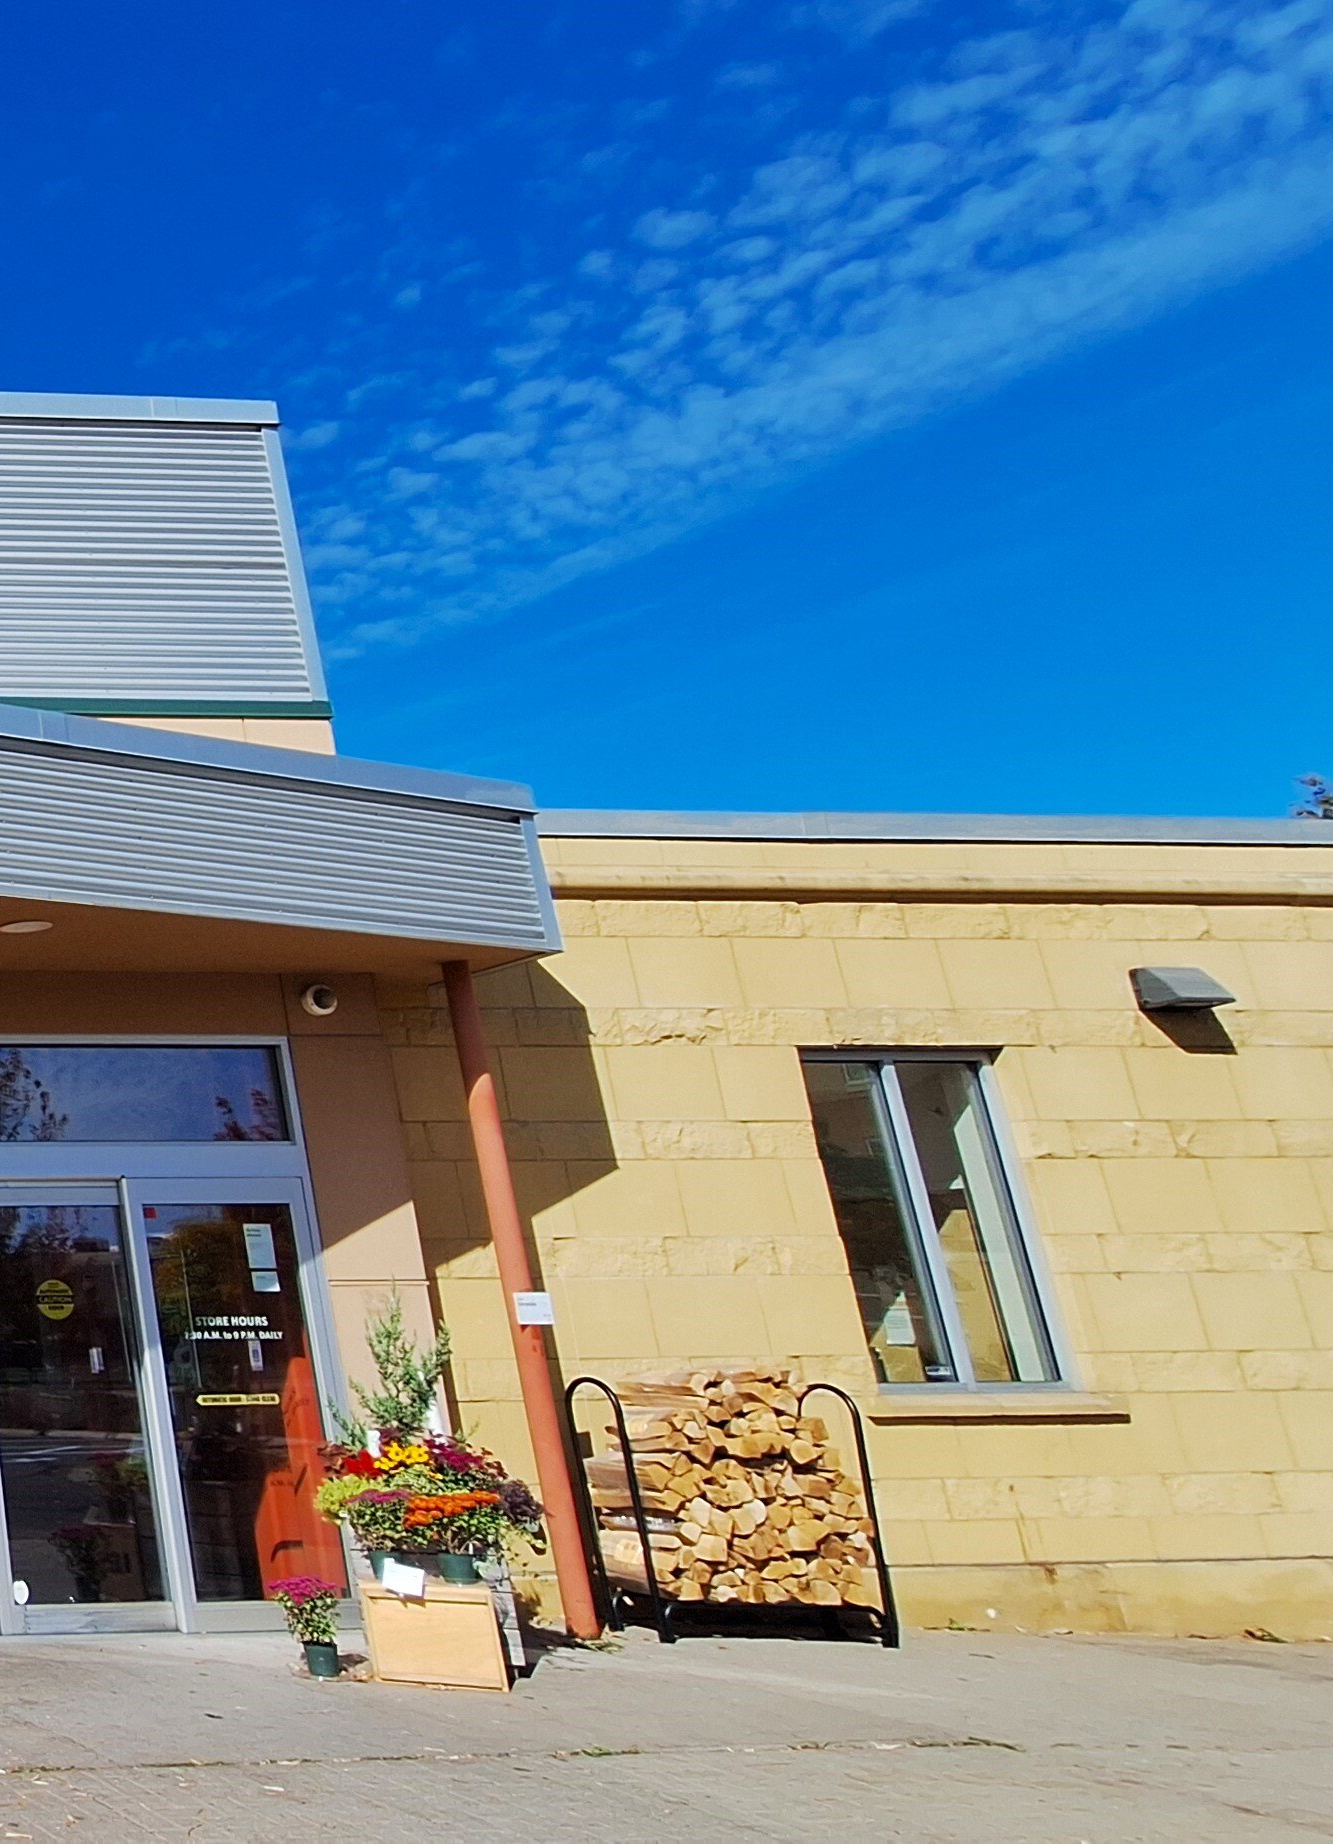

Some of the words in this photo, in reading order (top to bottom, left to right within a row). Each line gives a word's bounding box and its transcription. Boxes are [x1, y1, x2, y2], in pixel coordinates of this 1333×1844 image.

[195, 1316, 230, 1326] STORE
[231, 1316, 269, 1326] HOURS
[222, 1331, 232, 1340] to
[258, 1331, 283, 1340] DAILY
